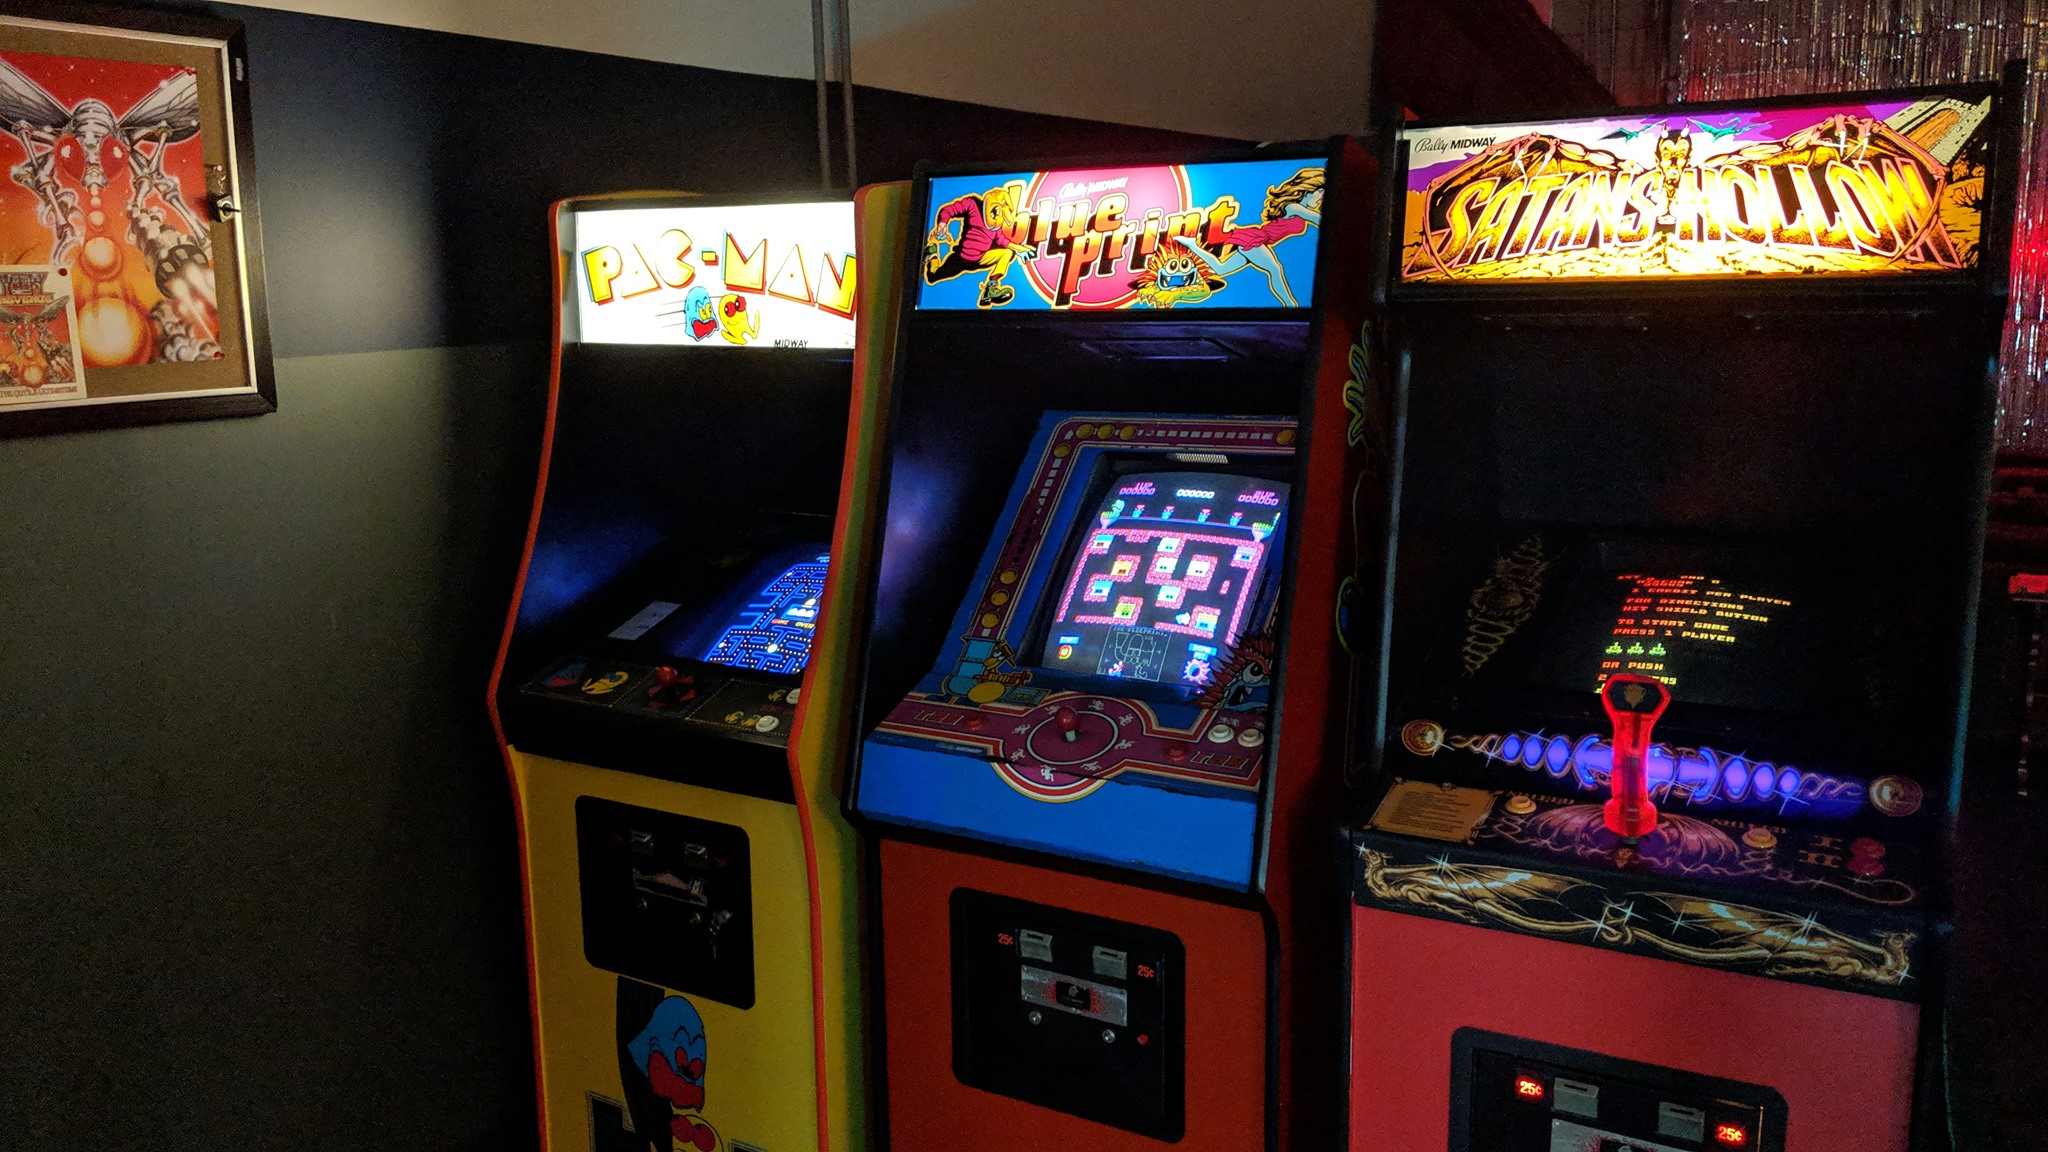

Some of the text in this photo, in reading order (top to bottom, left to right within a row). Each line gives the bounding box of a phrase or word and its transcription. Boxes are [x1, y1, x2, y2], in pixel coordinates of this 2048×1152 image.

[1414, 137, 1496, 154] Bally MIDWAY
[1002, 179, 1128, 246] blue
[1679, 157, 1962, 268] HOLLOW
[1060, 200, 1237, 296] print
[581, 229, 857, 321] PAC-MAN
[774, 339, 808, 348] MIDWAY
[1176, 489, 1215, 499] 000000
[1659, 598, 1744, 610] DIRECTIONS
[1706, 590, 1731, 598] PER
[1740, 594, 1792, 606] PLAYER
[1656, 606, 1707, 615] SHIELD
[1716, 611, 1769, 623] BUTTON
[795, 621, 815, 629] OVER
[1642, 619, 1685, 627] START
[1694, 622, 1729, 632] GAME
[1613, 628, 1736, 643] PRESS 1 PLAYER
[1602, 661, 1664, 671] OR PUSH
[998, 933, 1013, 946] 25¢
[1137, 965, 1155, 978] 25¢
[1519, 1080, 1543, 1097] 25¢
[1718, 1126, 1743, 1143] 25¢
